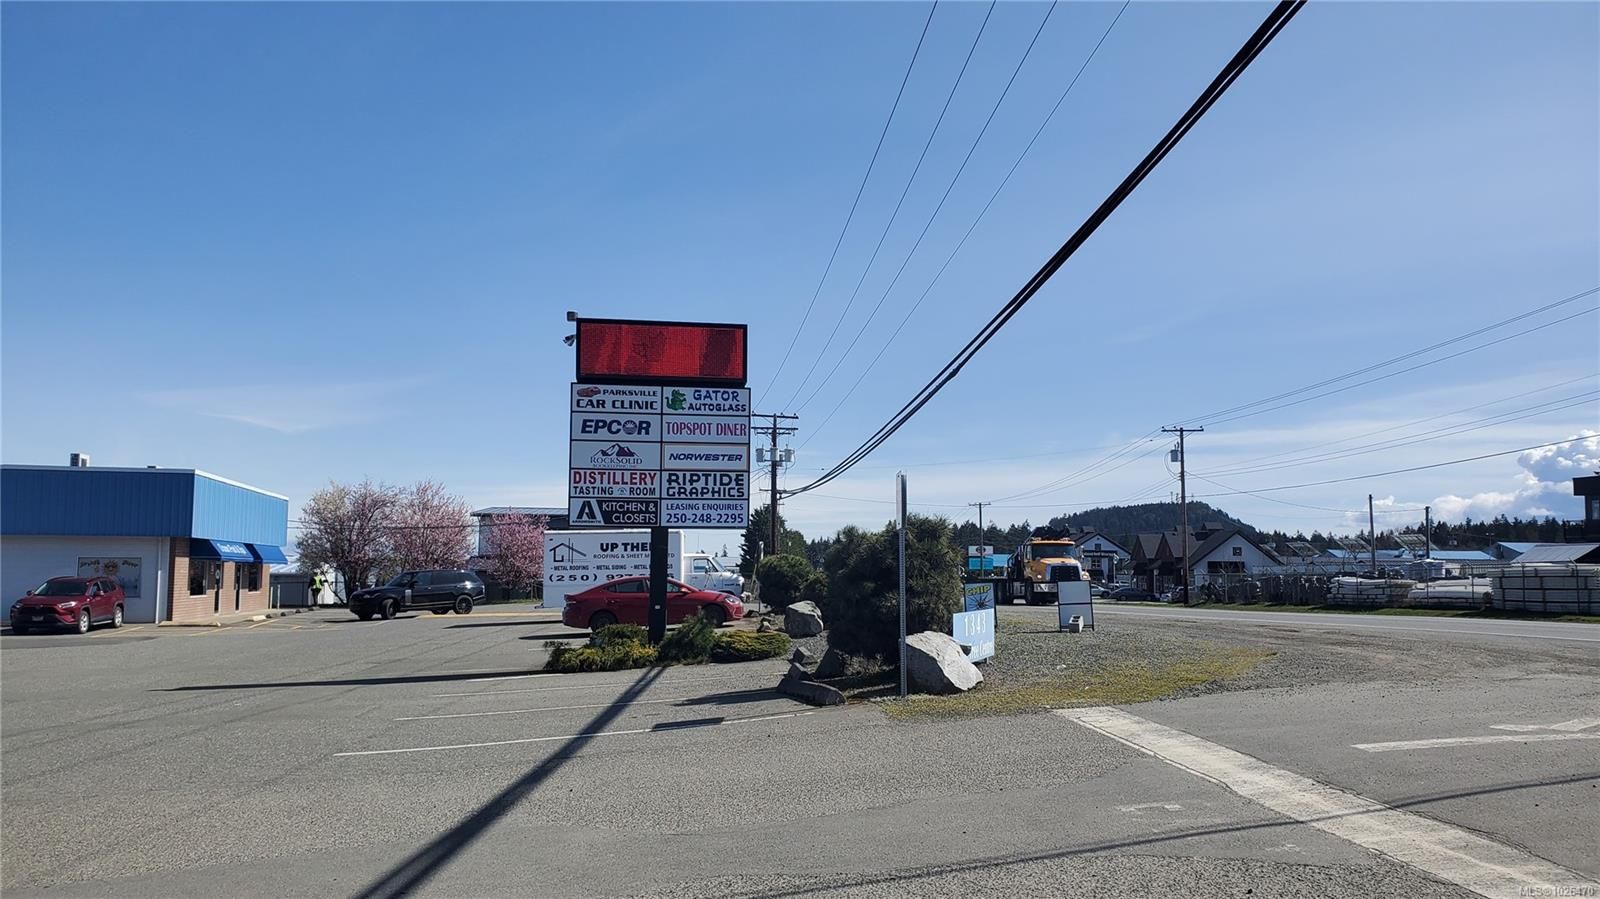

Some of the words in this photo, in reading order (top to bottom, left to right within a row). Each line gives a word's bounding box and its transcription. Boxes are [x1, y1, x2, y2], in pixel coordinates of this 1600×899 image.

[603, 389, 658, 397] PARKSVILLE
[693, 389, 740, 402] GATOR
[576, 399, 606, 409] CAR
[611, 399, 658, 410] CLINIC
[687, 402, 747, 412] AUTOGLASS
[581, 419, 651, 435] EPCOR
[665, 421, 713, 436] TOPSPOT
[716, 423, 747, 437] DINER
[669, 453, 743, 462] NORWESTER
[573, 471, 656, 485] DISTILLERY
[666, 472, 744, 487] RIPTIDE
[573, 486, 614, 496] TASTING
[629, 486, 656, 496] ROOM
[666, 486, 745, 498] GRAPHICS
[602, 502, 646, 511] KITCHEN
[648, 502, 656, 512] &
[666, 503, 700, 511] LEASING
[702, 503, 744, 512] ENQUIRIES
[612, 513, 656, 523] CLOSETS
[666, 512, 744, 524] 250-248-2295
[600, 542, 619, 552] UP
[621, 542, 652, 552] THE
[549, 573, 598, 582] (250)
